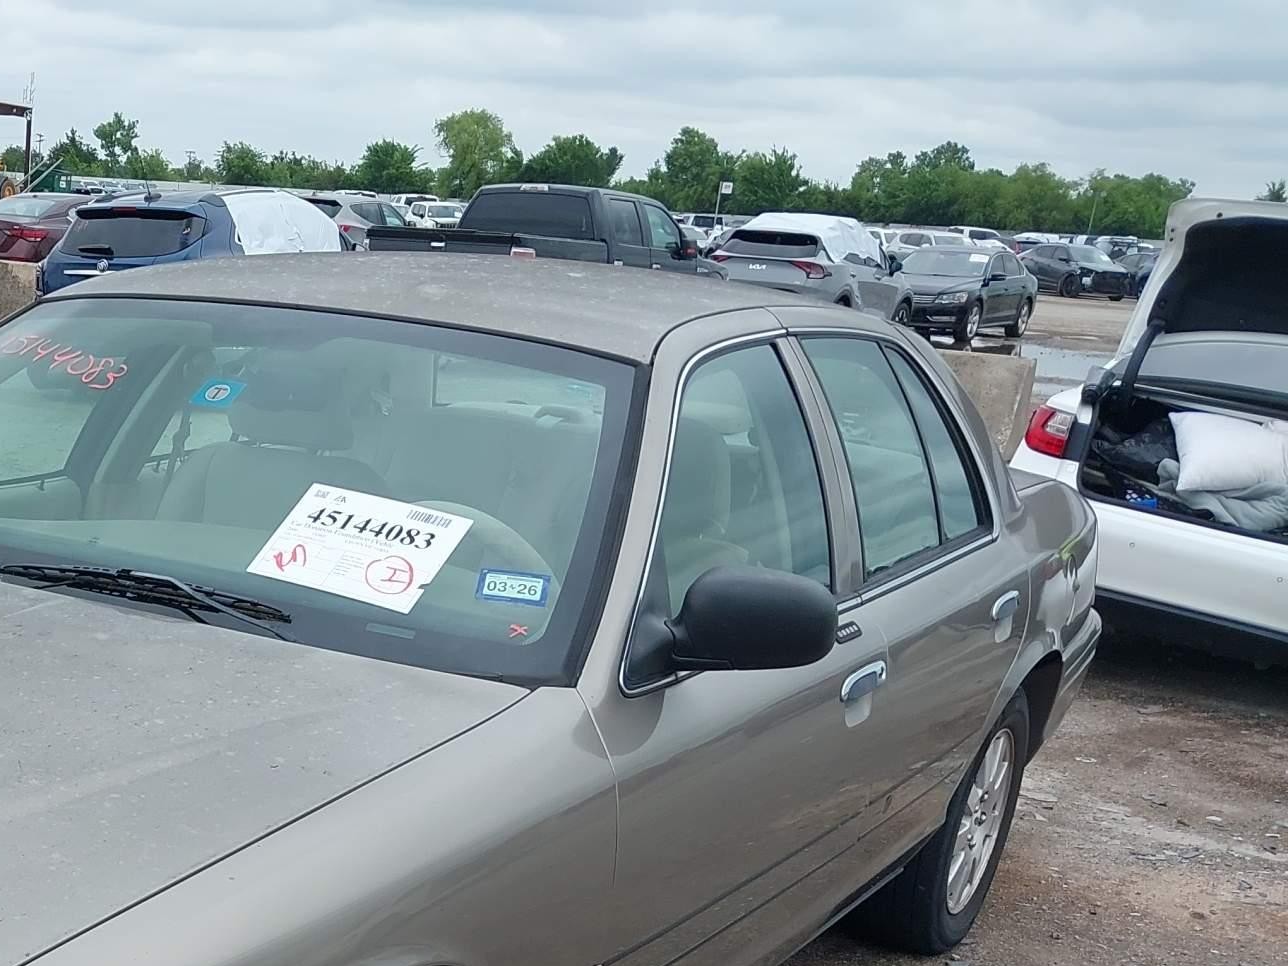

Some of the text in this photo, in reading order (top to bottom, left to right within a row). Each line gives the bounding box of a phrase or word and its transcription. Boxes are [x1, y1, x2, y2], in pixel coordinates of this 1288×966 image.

[307, 507, 436, 550] 45144083
[486, 580, 538, 597] 03 26
